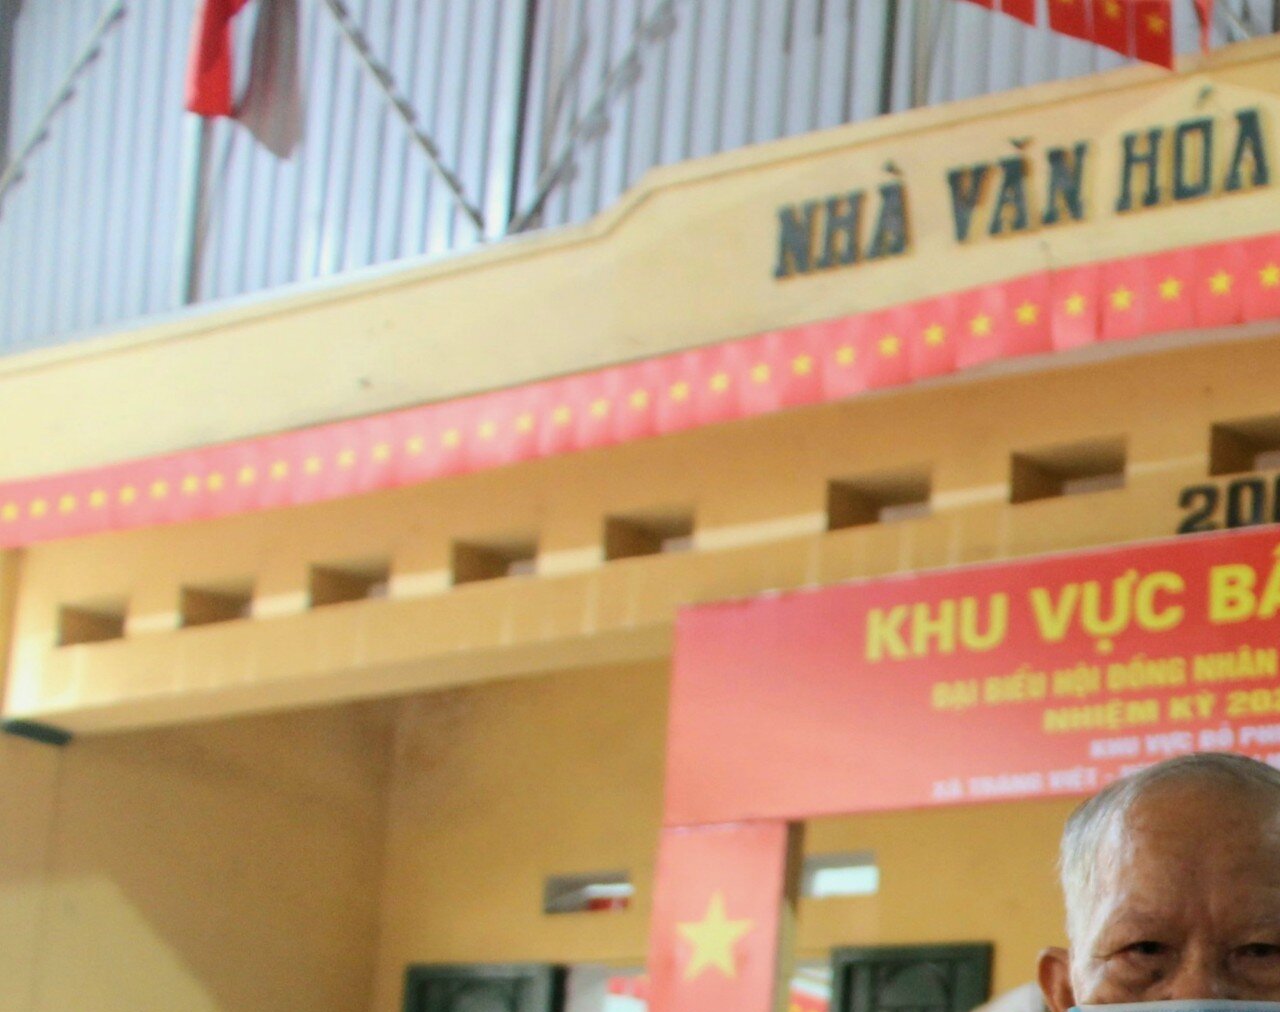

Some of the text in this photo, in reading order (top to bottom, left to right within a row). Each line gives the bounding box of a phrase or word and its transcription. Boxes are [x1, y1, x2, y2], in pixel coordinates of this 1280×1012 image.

[774, 160, 913, 281] NHÀ
[946, 136, 1089, 244] VĂN
[1116, 84, 1269, 212] HÓA
[866, 596, 1007, 662] KHU
[1031, 571, 1185, 653] VỰC
[1194, 644, 1278, 681] NHÂN
[1043, 698, 1158, 733] NHIỆM
[1169, 689, 1214, 721] KỲ
